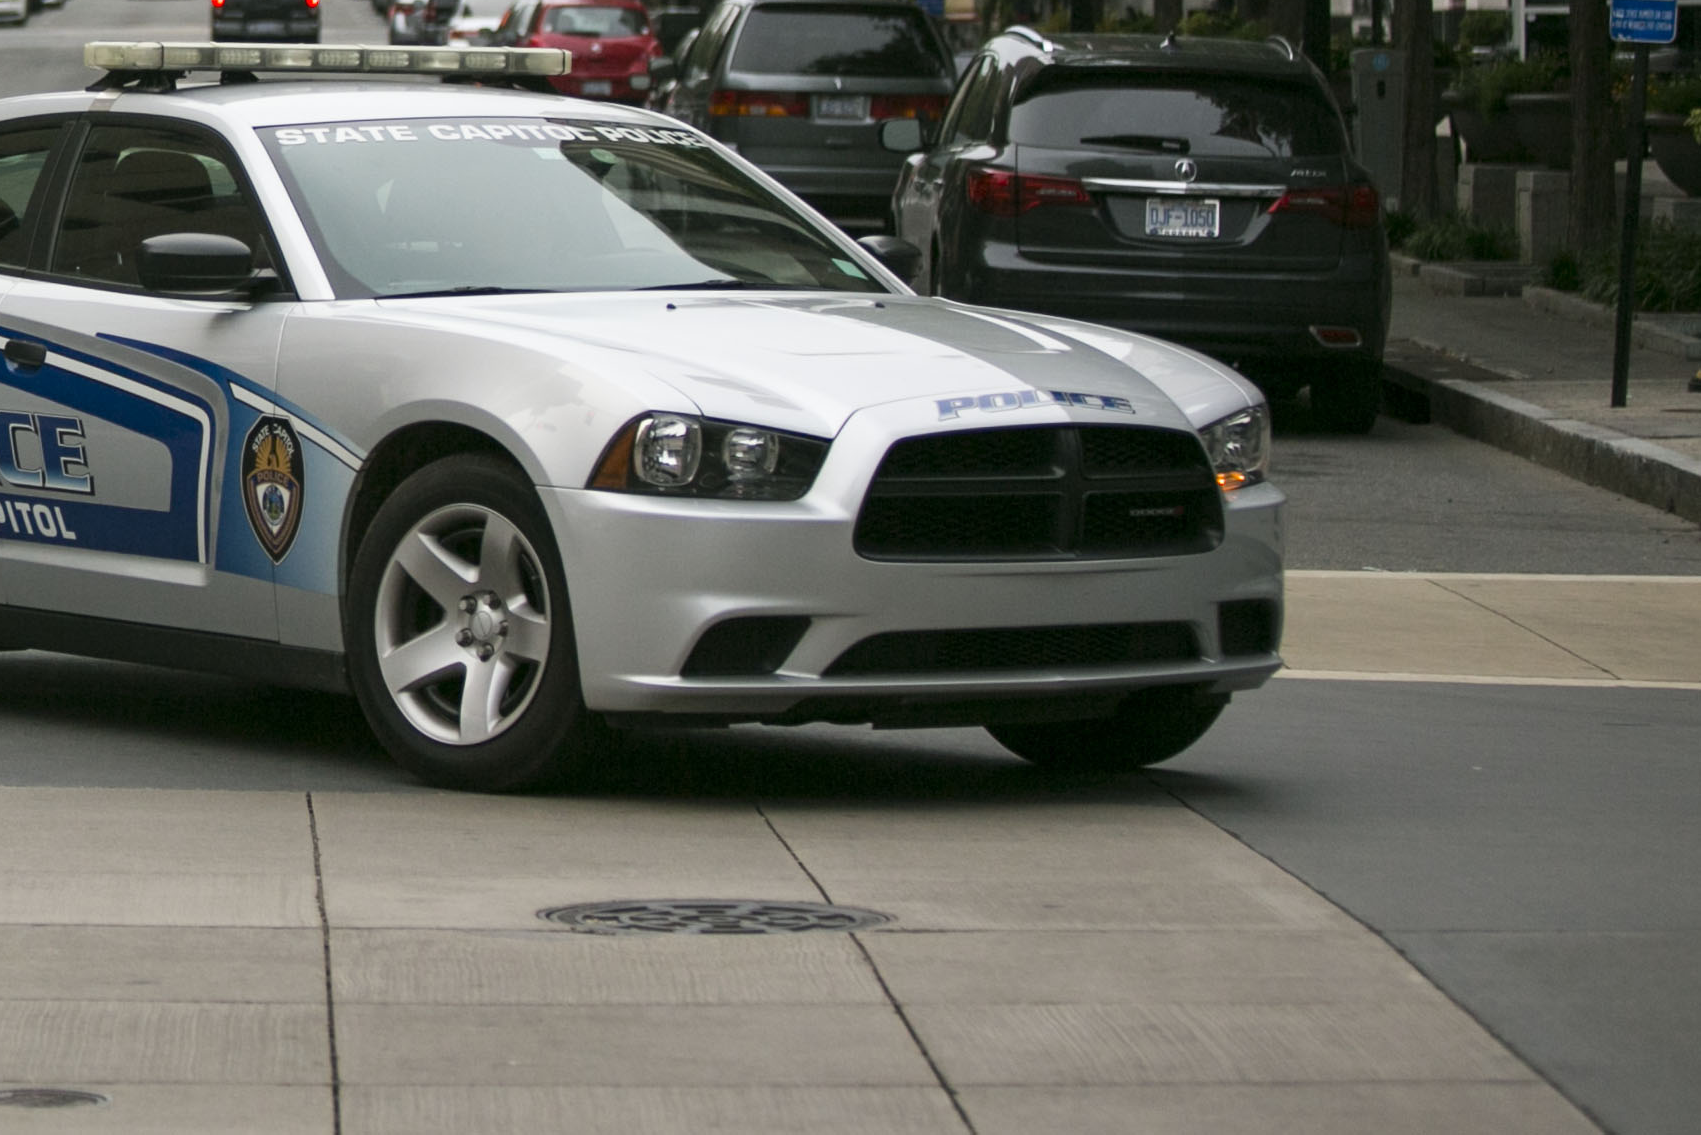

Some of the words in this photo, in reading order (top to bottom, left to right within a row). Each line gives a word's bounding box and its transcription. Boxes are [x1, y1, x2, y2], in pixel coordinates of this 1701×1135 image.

[275, 126, 419, 146] STATE
[427, 124, 600, 142] CAPITOL
[593, 126, 710, 148] POLICE
[934, 389, 1137, 422] POLICE
[252, 424, 271, 453] STATE
[273, 423, 296, 458] CAPITOL
[257, 470, 290, 485] POLICE
